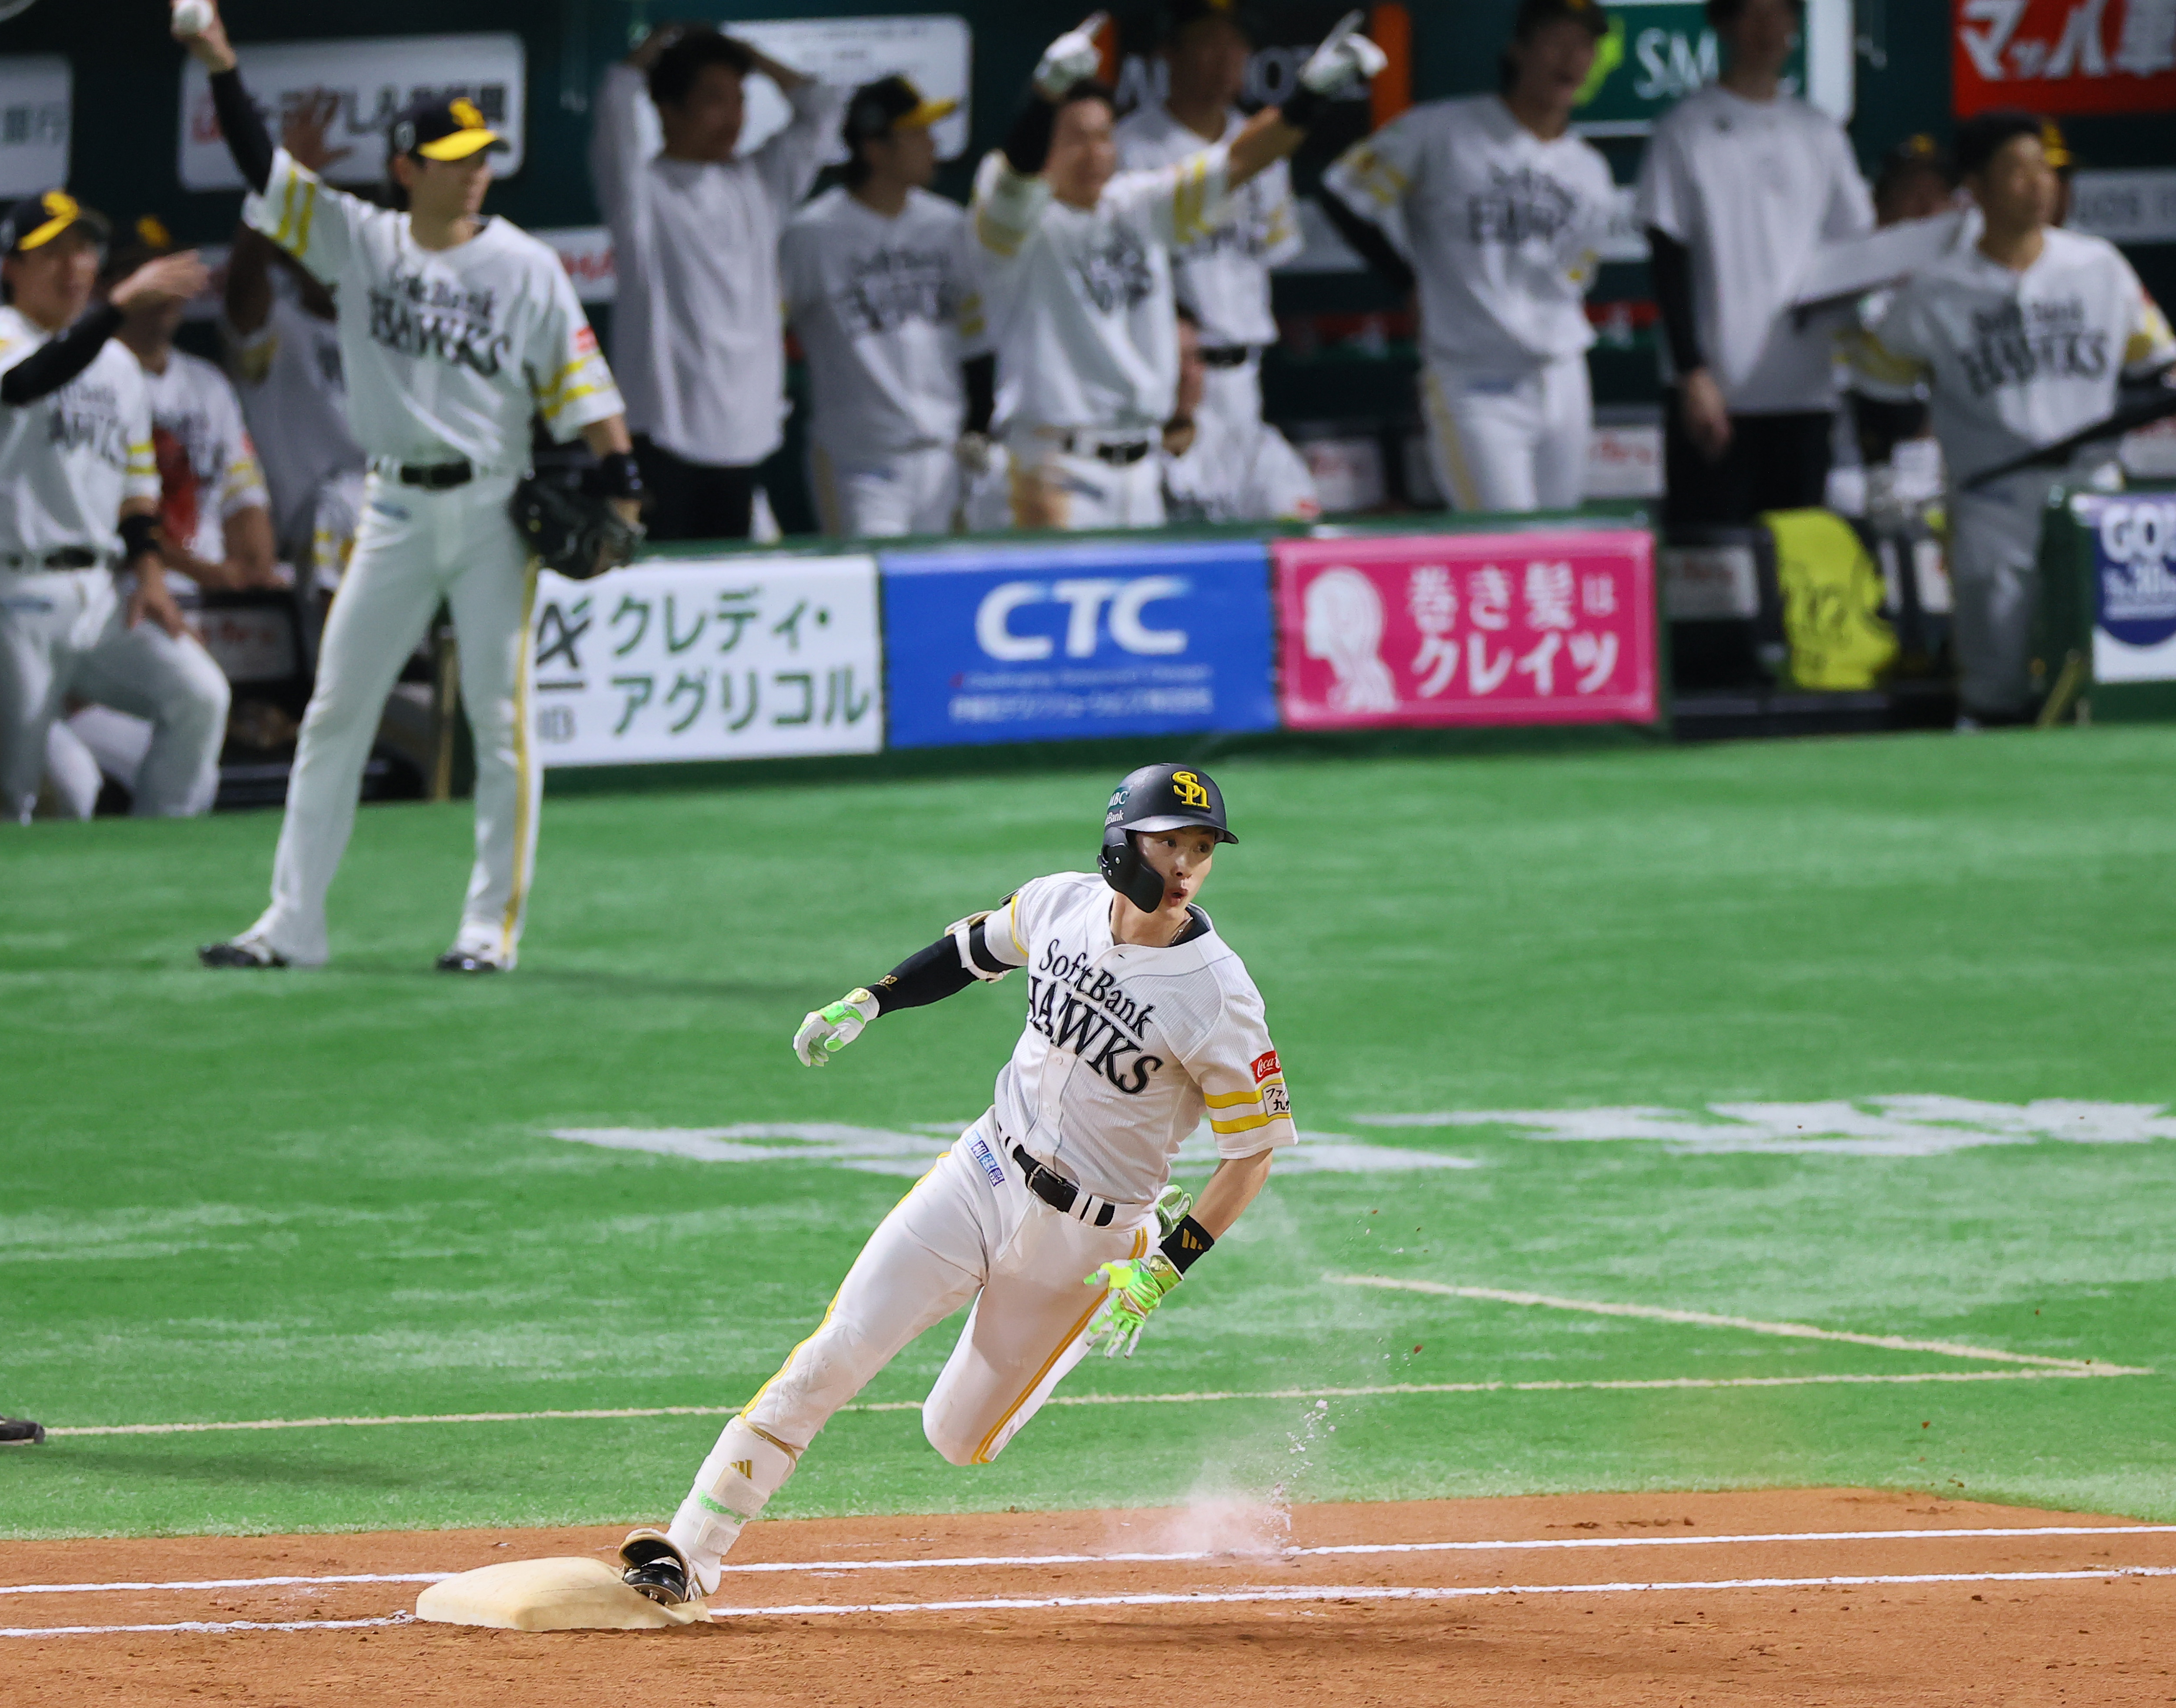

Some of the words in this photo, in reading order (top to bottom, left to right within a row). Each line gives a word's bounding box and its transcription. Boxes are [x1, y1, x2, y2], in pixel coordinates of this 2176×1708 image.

[975, 575, 1193, 661] CTC
[1411, 632, 1619, 697] クレイツ
[611, 666, 870, 735] アグリコル
[1108, 790, 1128, 808] MBC
[1039, 939, 1156, 1040] SoftBank
[1266, 1088, 1286, 1101] ファ
